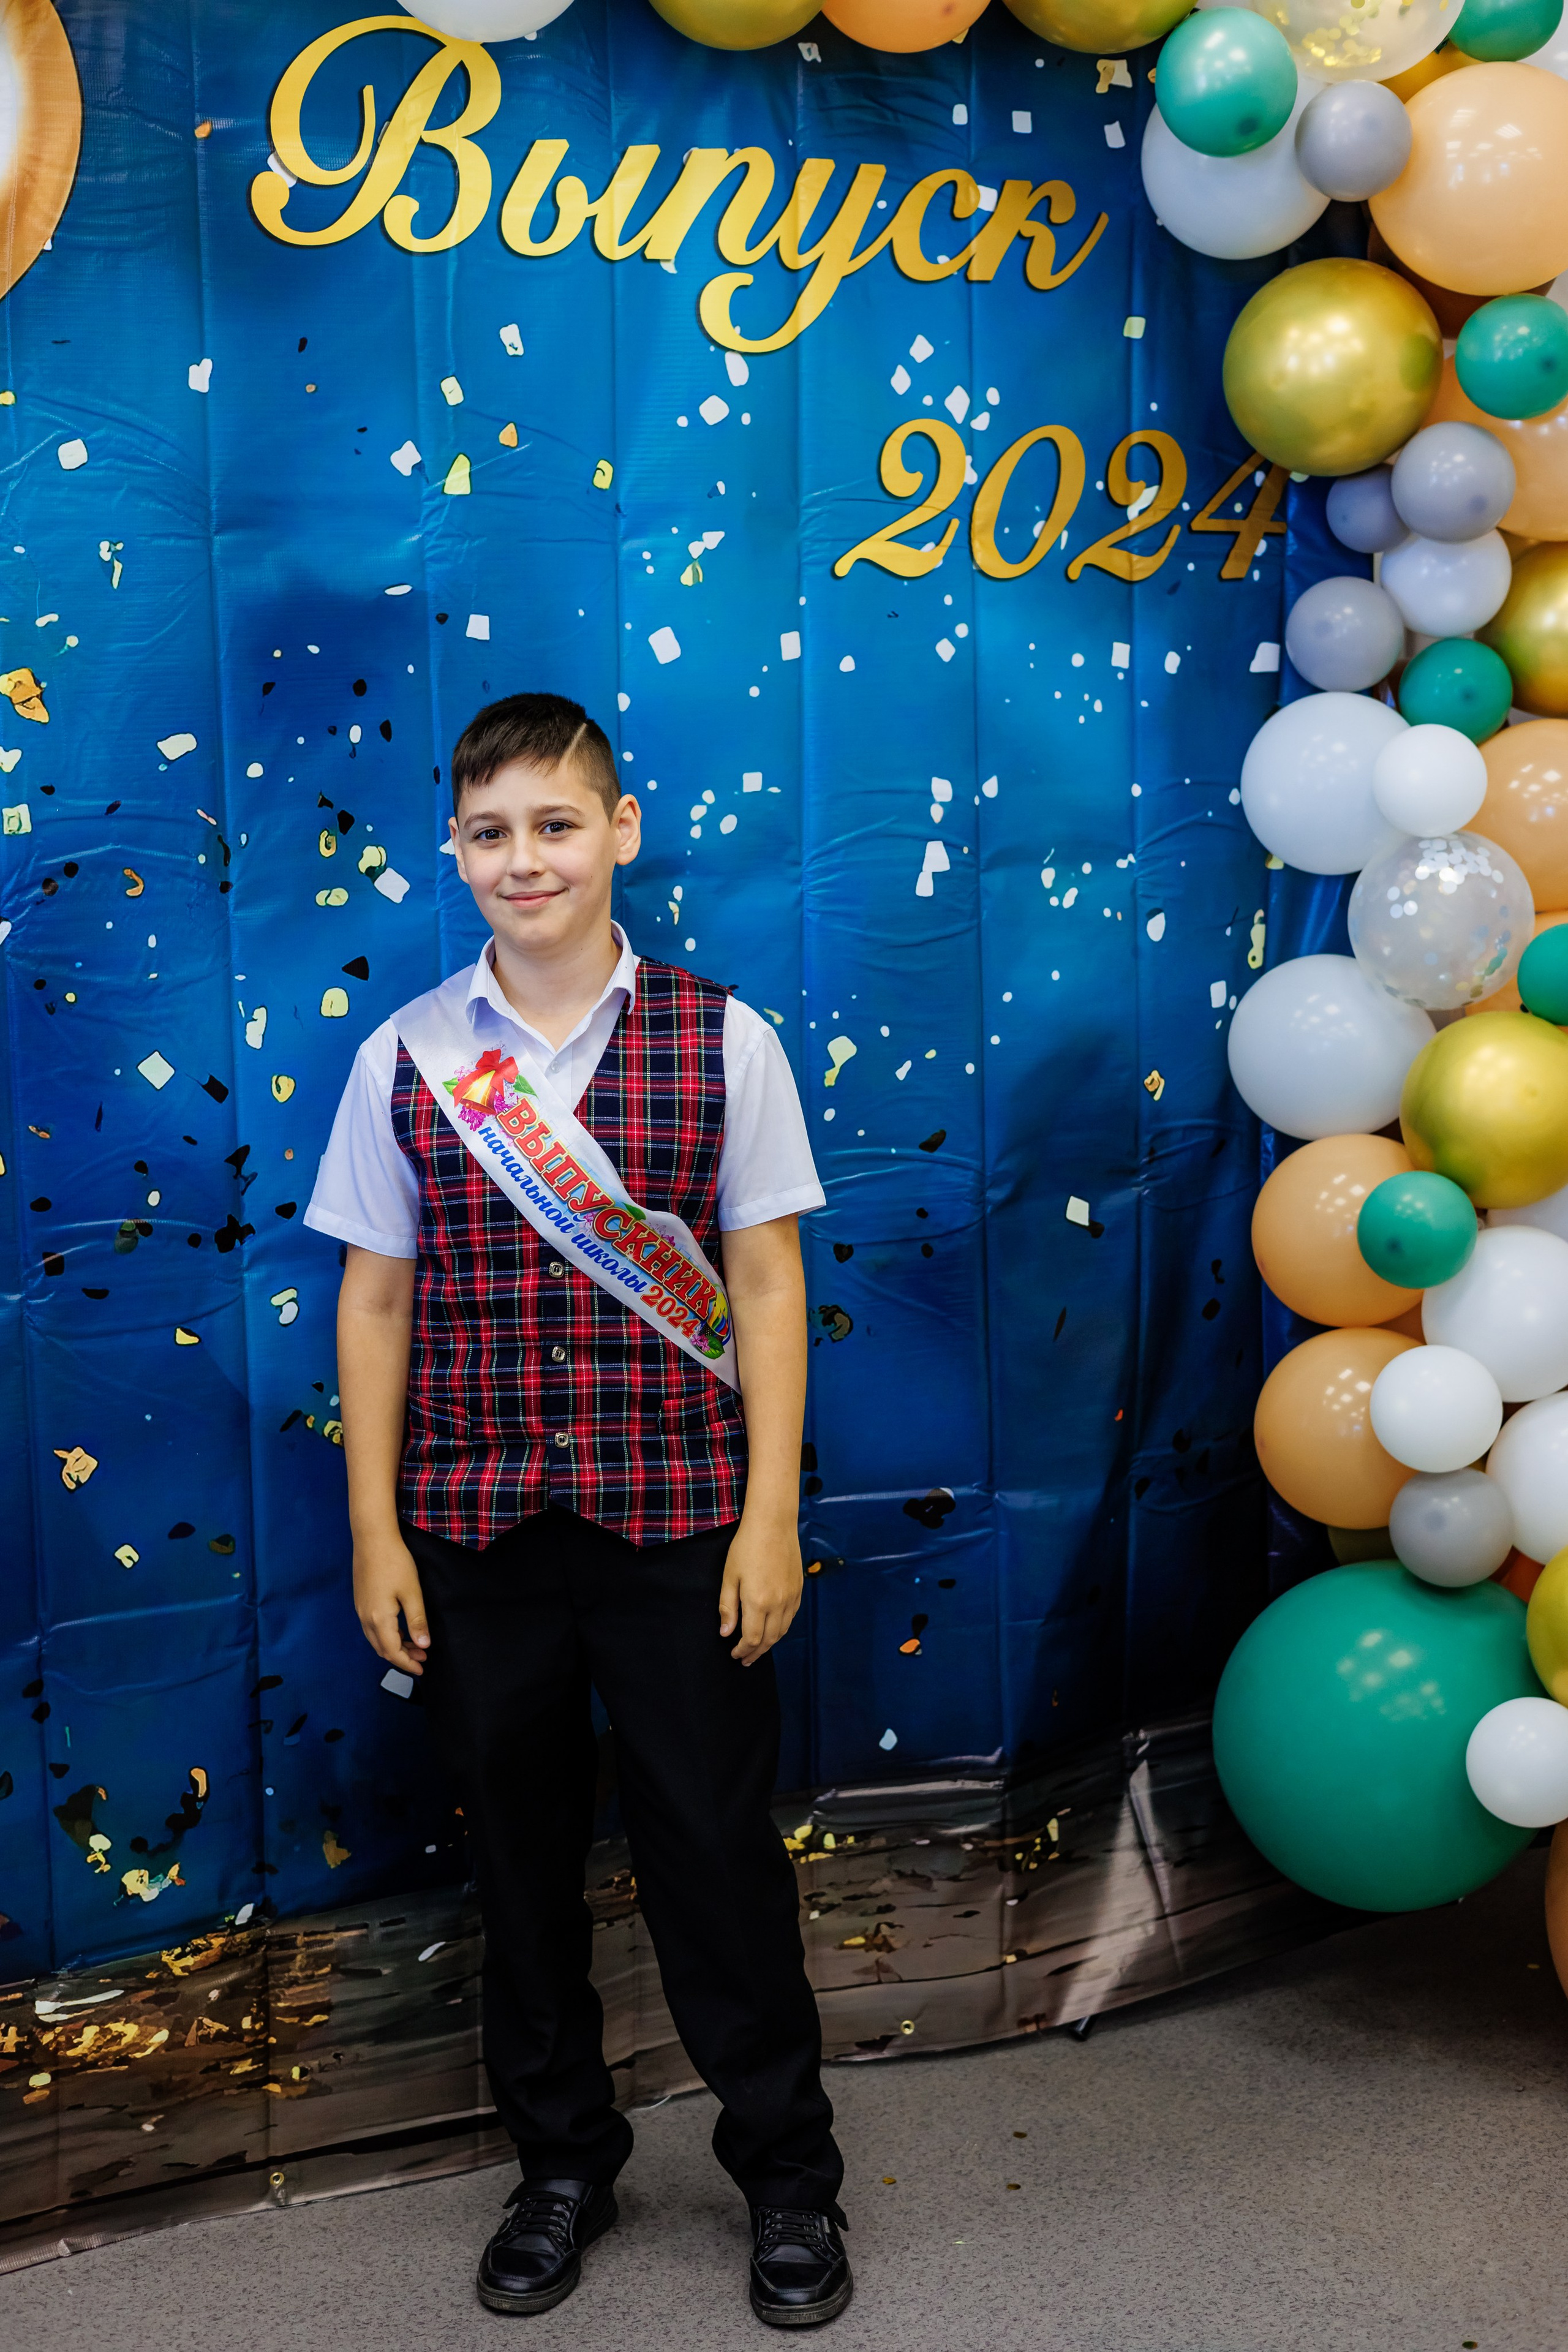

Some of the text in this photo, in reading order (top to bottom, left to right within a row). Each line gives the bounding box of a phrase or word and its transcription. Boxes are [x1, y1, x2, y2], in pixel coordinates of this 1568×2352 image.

[251, 15, 1109, 353] Выпуск
[834, 418, 1291, 581] 2024
[478, 1127, 699, 1338] начальной школы 2024
[497, 1098, 717, 1319] ВЫПУСКНИК
